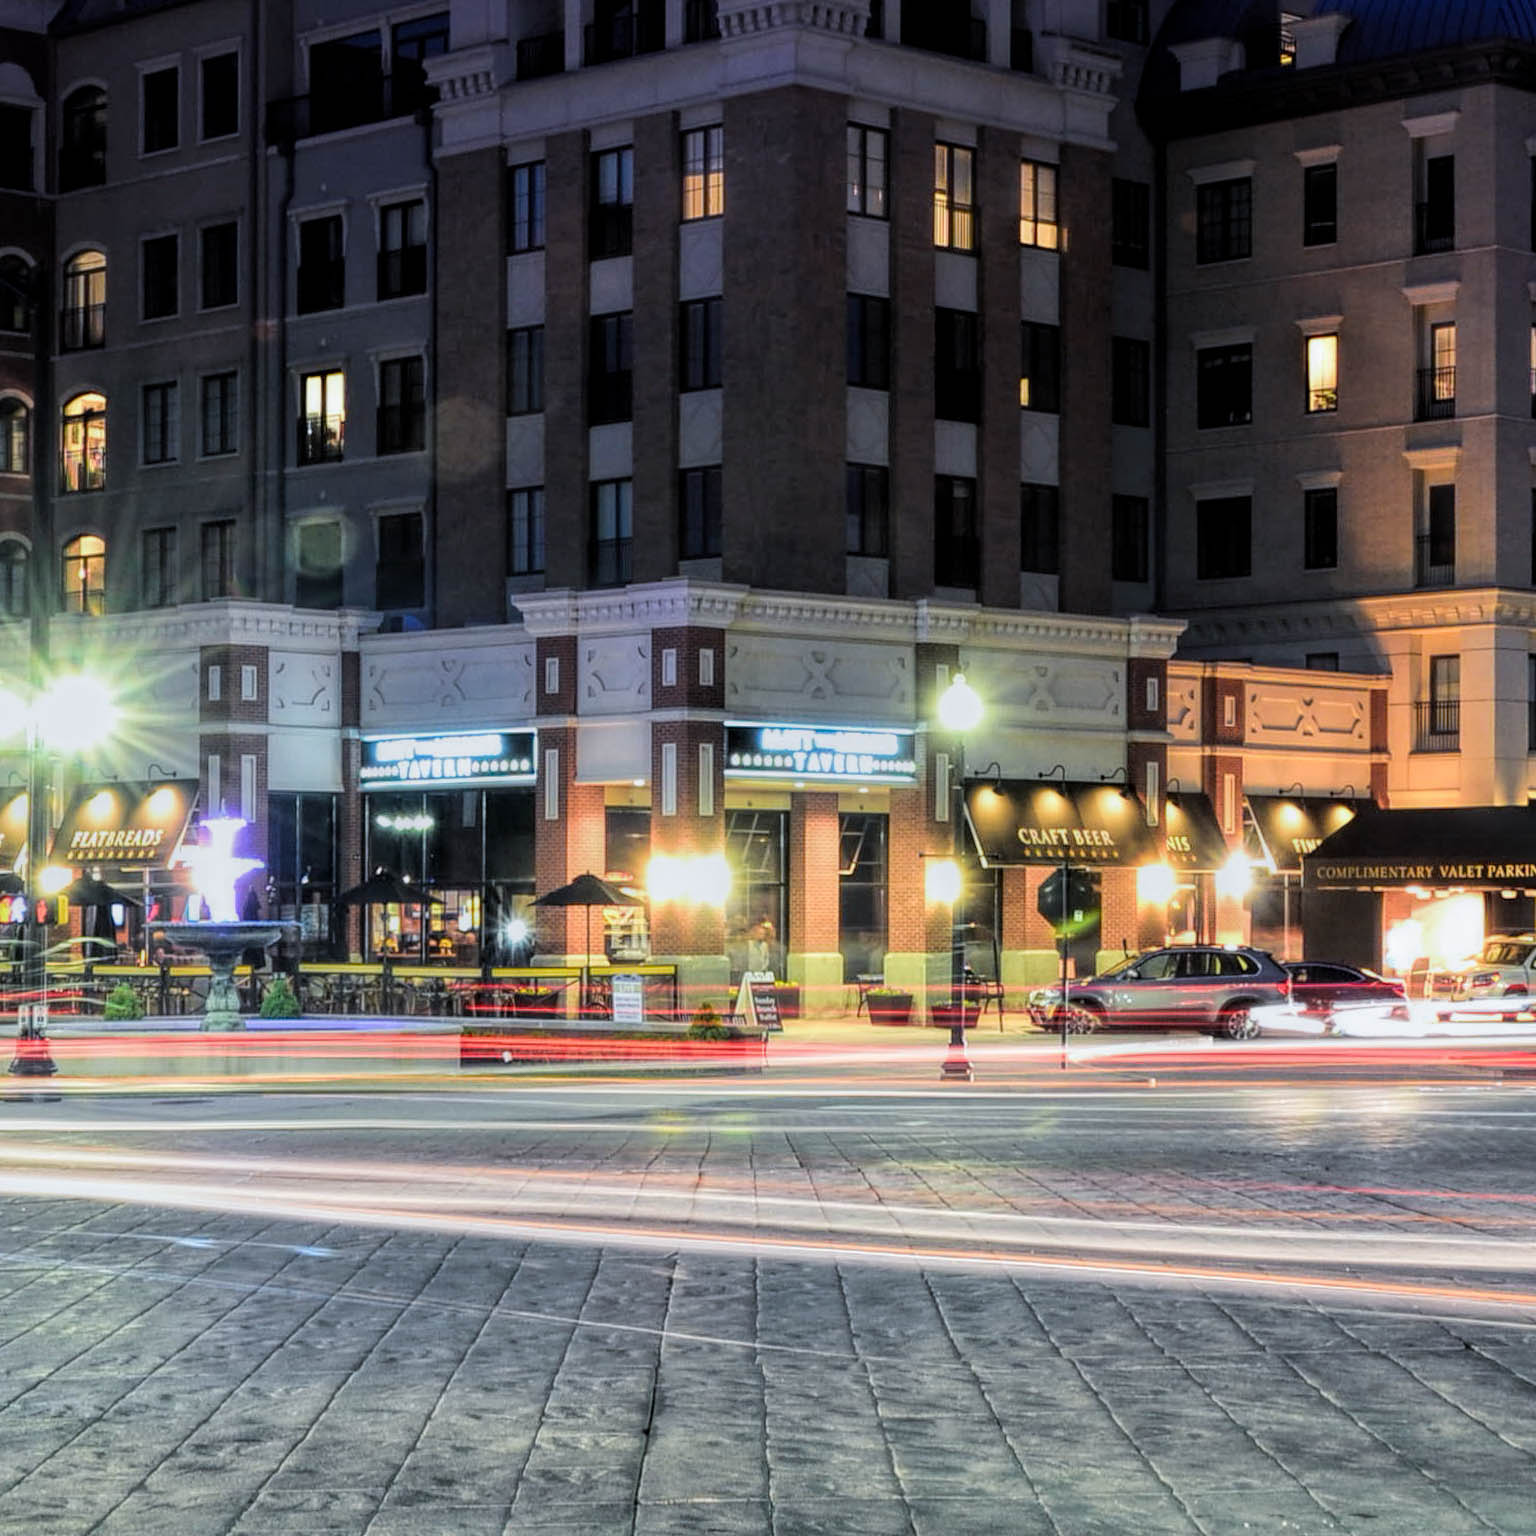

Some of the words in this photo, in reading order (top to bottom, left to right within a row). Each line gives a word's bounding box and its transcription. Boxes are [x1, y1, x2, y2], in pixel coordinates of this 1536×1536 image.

[397, 757, 472, 780] TAVERN
[792, 751, 873, 774] TAVERN
[70, 829, 164, 849] FLATBREADS
[1018, 827, 1068, 845] CRAFT
[1072, 830, 1115, 846] BEER
[1316, 866, 1433, 880] COMPLIMENTARY
[1439, 864, 1484, 879] VALET
